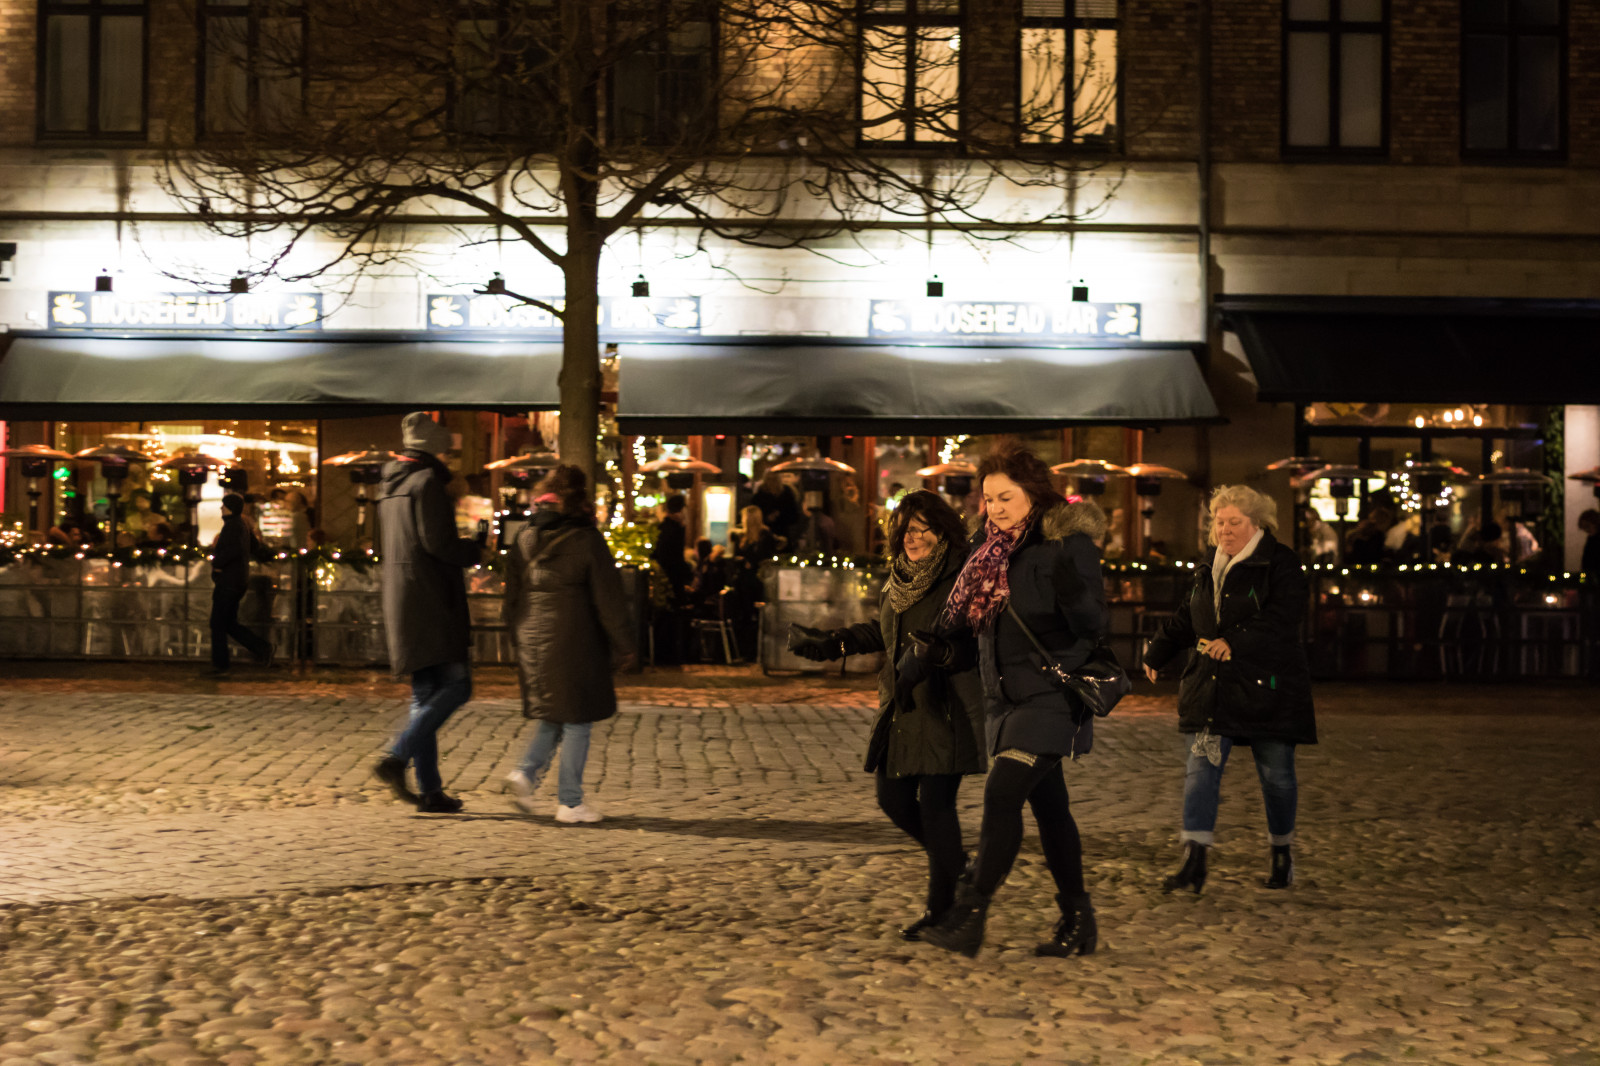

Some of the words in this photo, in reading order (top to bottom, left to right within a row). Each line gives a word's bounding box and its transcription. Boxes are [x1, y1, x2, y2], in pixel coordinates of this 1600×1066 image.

[90, 296, 226, 325] MOOSEHEAD
[232, 297, 280, 325] BAR
[911, 303, 1046, 333] MOOSEHEAD
[1051, 304, 1099, 334] BAR
